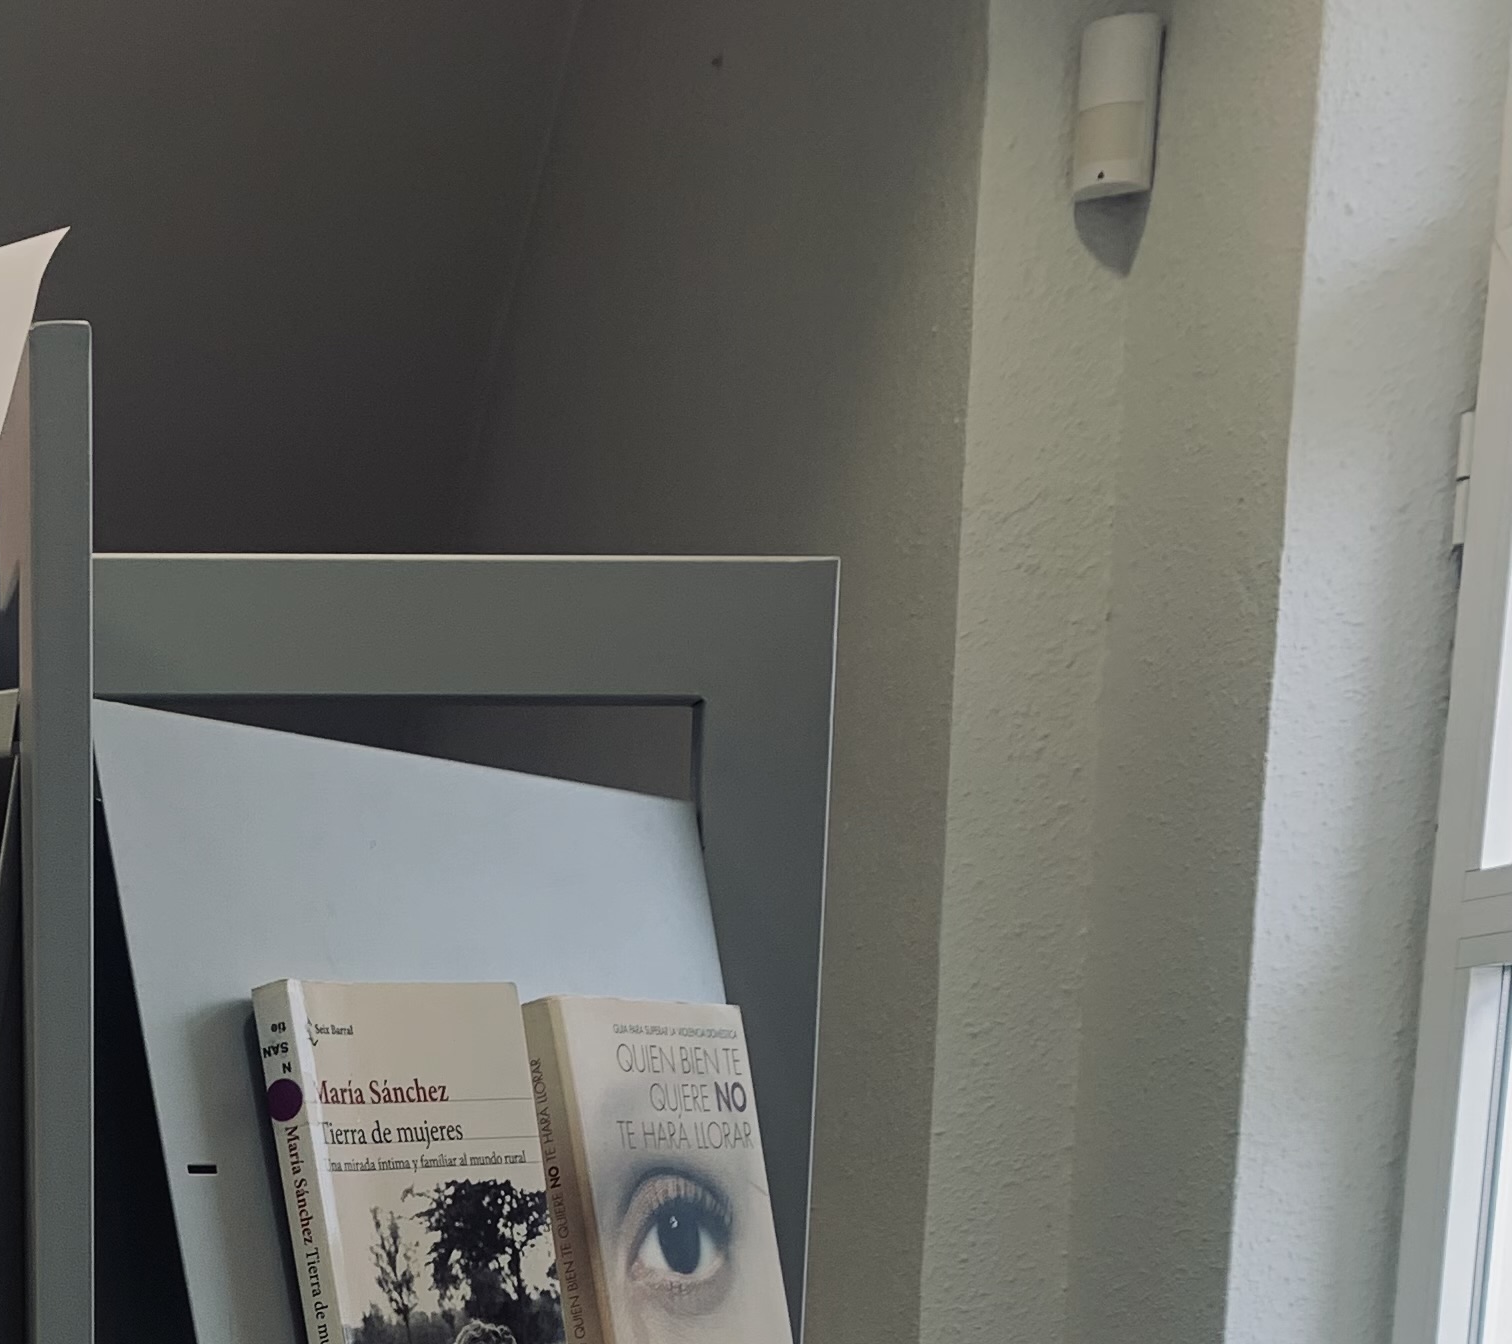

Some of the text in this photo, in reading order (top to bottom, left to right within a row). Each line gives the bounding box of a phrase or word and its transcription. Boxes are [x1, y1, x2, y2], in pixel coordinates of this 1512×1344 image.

[315, 1023, 353, 1036] Seix Barral
[262, 1041, 290, 1059] SAN
[616, 1043, 742, 1076] QUIEN BIEN TE
[282, 1061, 292, 1074] N
[530, 1057, 549, 1103] LLORAR
[317, 1078, 449, 1105] María Sánchez
[649, 1081, 747, 1113] QUIERE NO
[320, 1120, 464, 1149] Tierra de mujeres
[616, 1120, 637, 1149] TE
[694, 1120, 754, 1149] LLORAR
[344, 1157, 376, 1171] mirada
[378, 1155, 411, 1170] íntima
[411, 1158, 418, 1173] y
[420, 1153, 457, 1169] familiar
[458, 1152, 467, 1166] al
[469, 1151, 502, 1166] mundo
[504, 1151, 526, 1164] rural
[545, 1146, 557, 1163] TE
[548, 1165, 561, 1189] NO
[285, 1126, 302, 1176] María
[294, 1178, 314, 1245] Sánchez
[304, 1246, 322, 1298] Tierra
[313, 1300, 325, 1321] de
[551, 1193, 569, 1239] QUIERE
[560, 1244, 572, 1259] TE
[562, 1260, 579, 1292] BIEN
[570, 1296, 586, 1339] QUIEN
